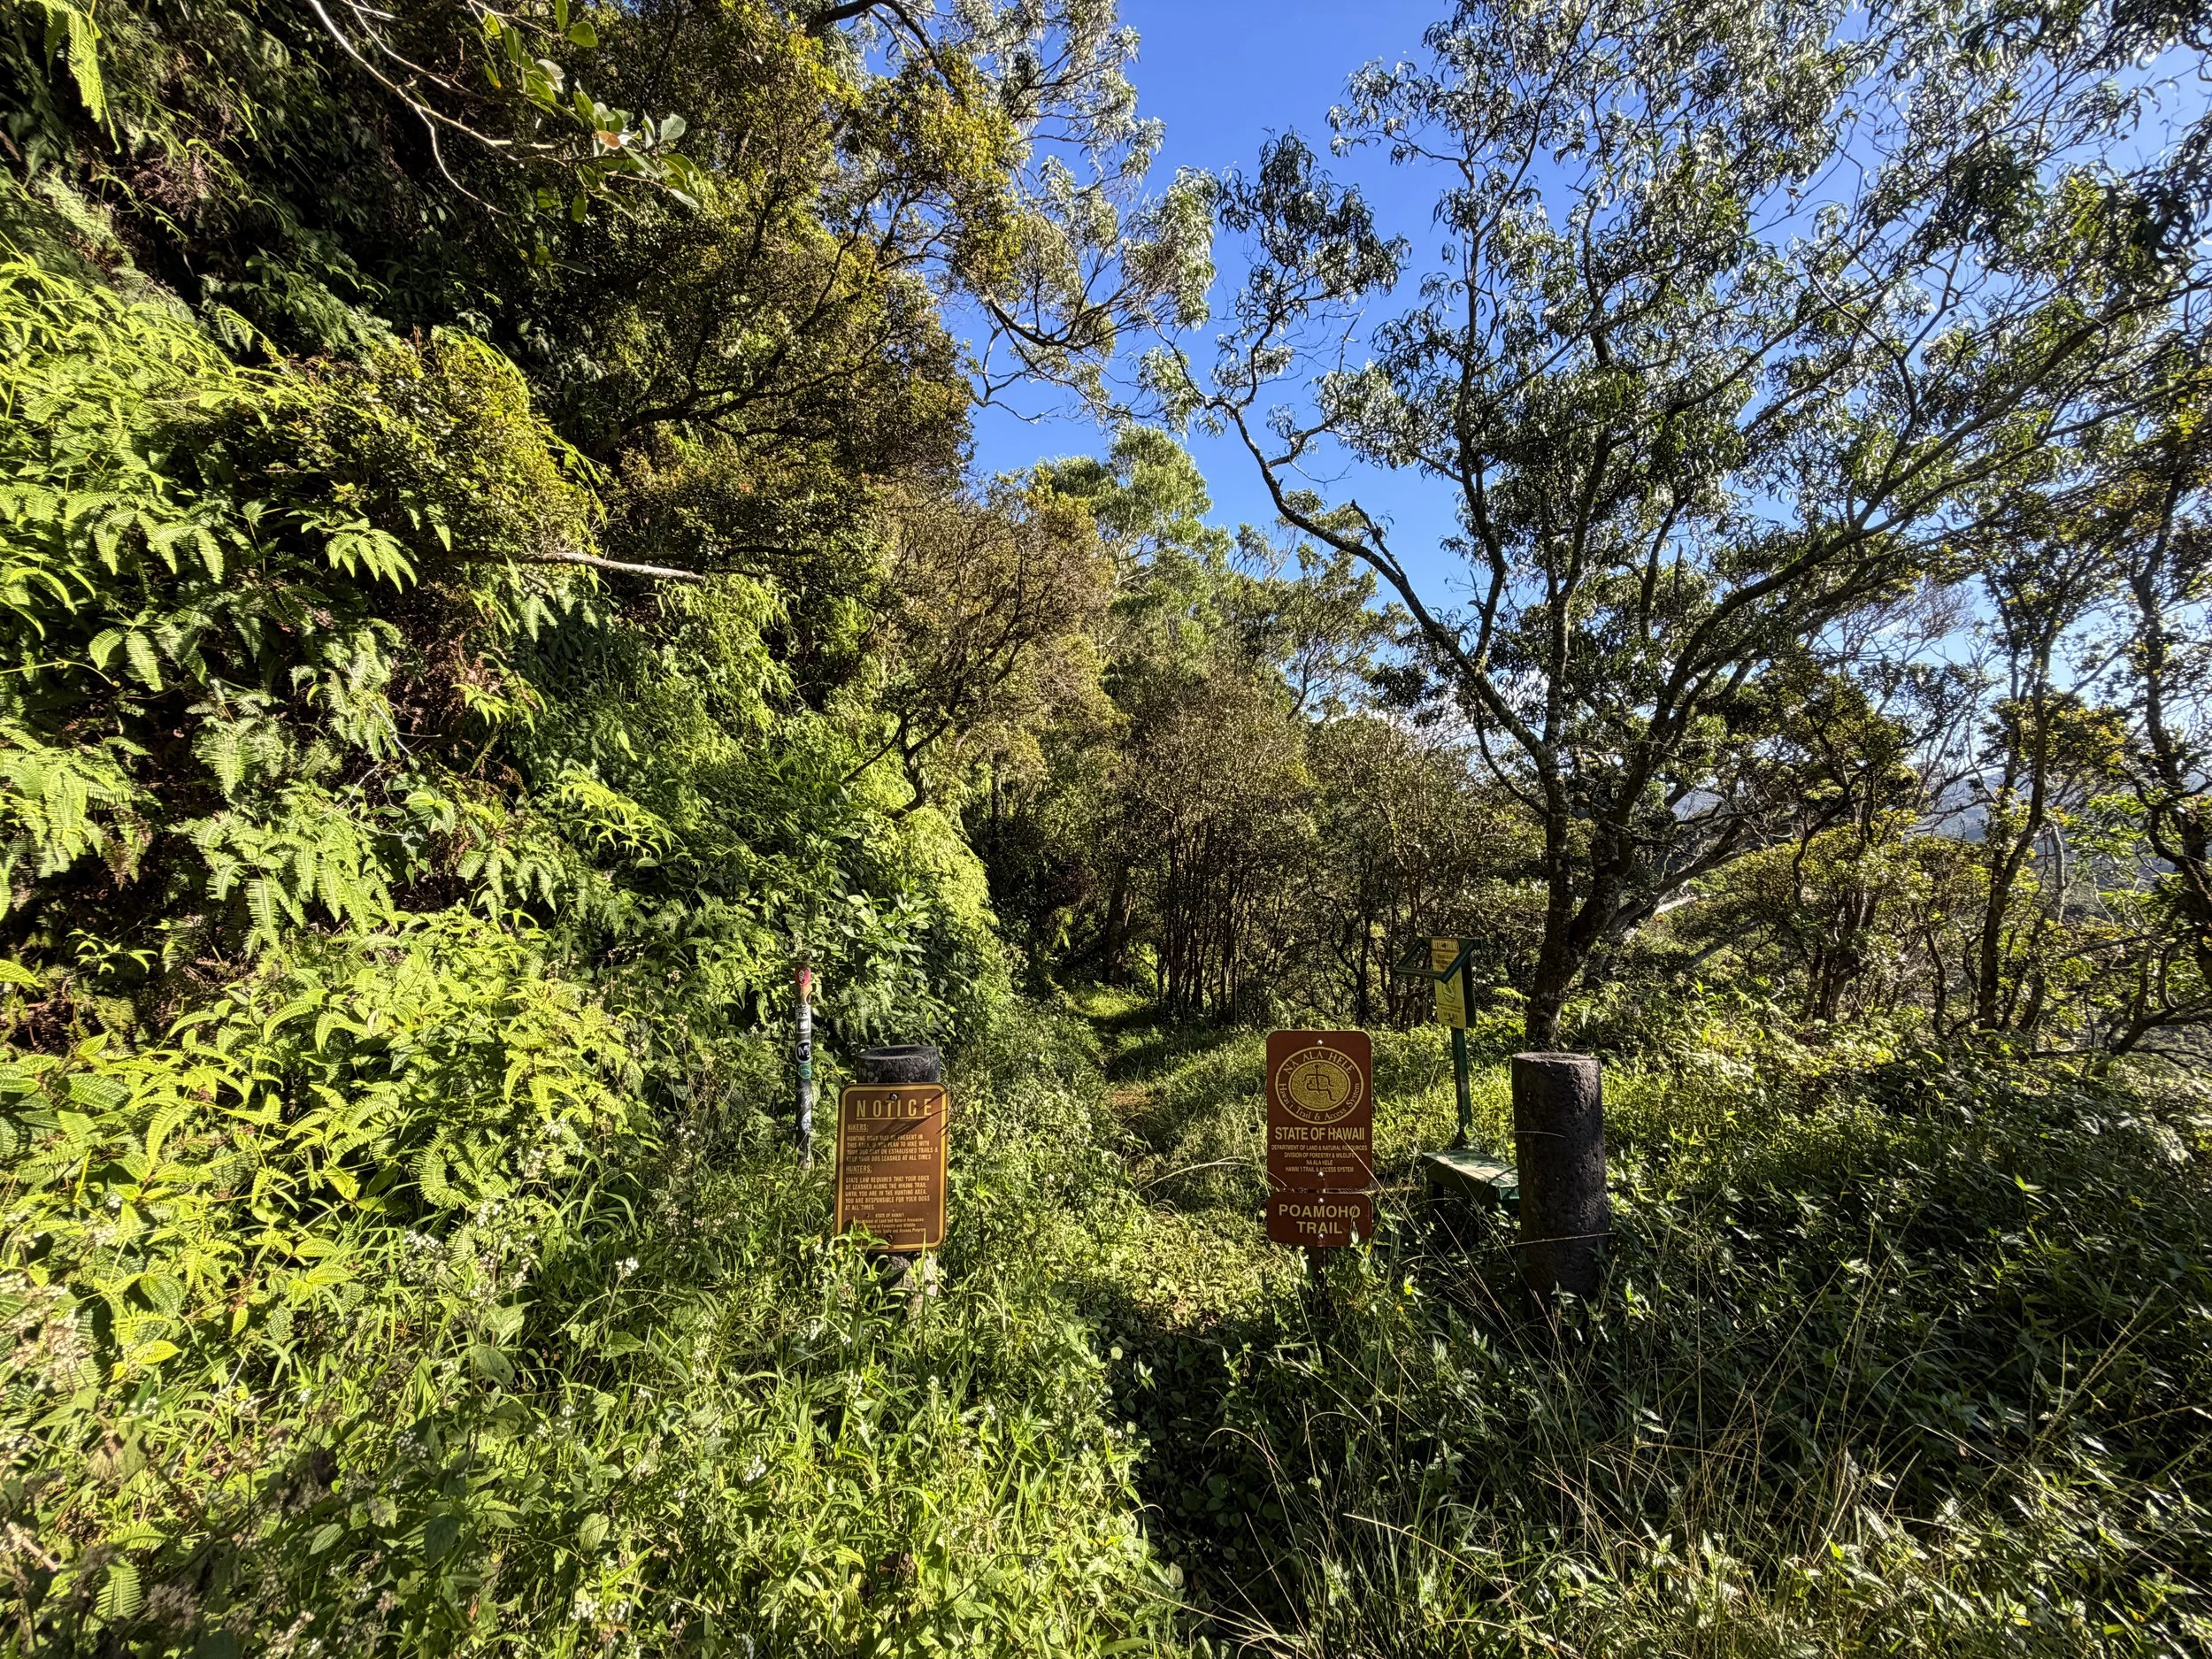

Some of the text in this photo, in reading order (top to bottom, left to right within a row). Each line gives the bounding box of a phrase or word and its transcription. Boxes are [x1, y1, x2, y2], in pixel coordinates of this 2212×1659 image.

[1302, 1050, 1323, 1062] ALA
[1328, 1052, 1355, 1074] HELE
[856, 1099, 932, 1118] NOTICE
[1295, 1106, 1311, 1119] Trail
[1324, 1108, 1346, 1120] Access
[1346, 1083, 1360, 1107] System
[1275, 1127, 1365, 1140] STATE OF HAWAII
[1279, 1204, 1360, 1218] POAMOHO
[1296, 1221, 1342, 1234] TRAIL
